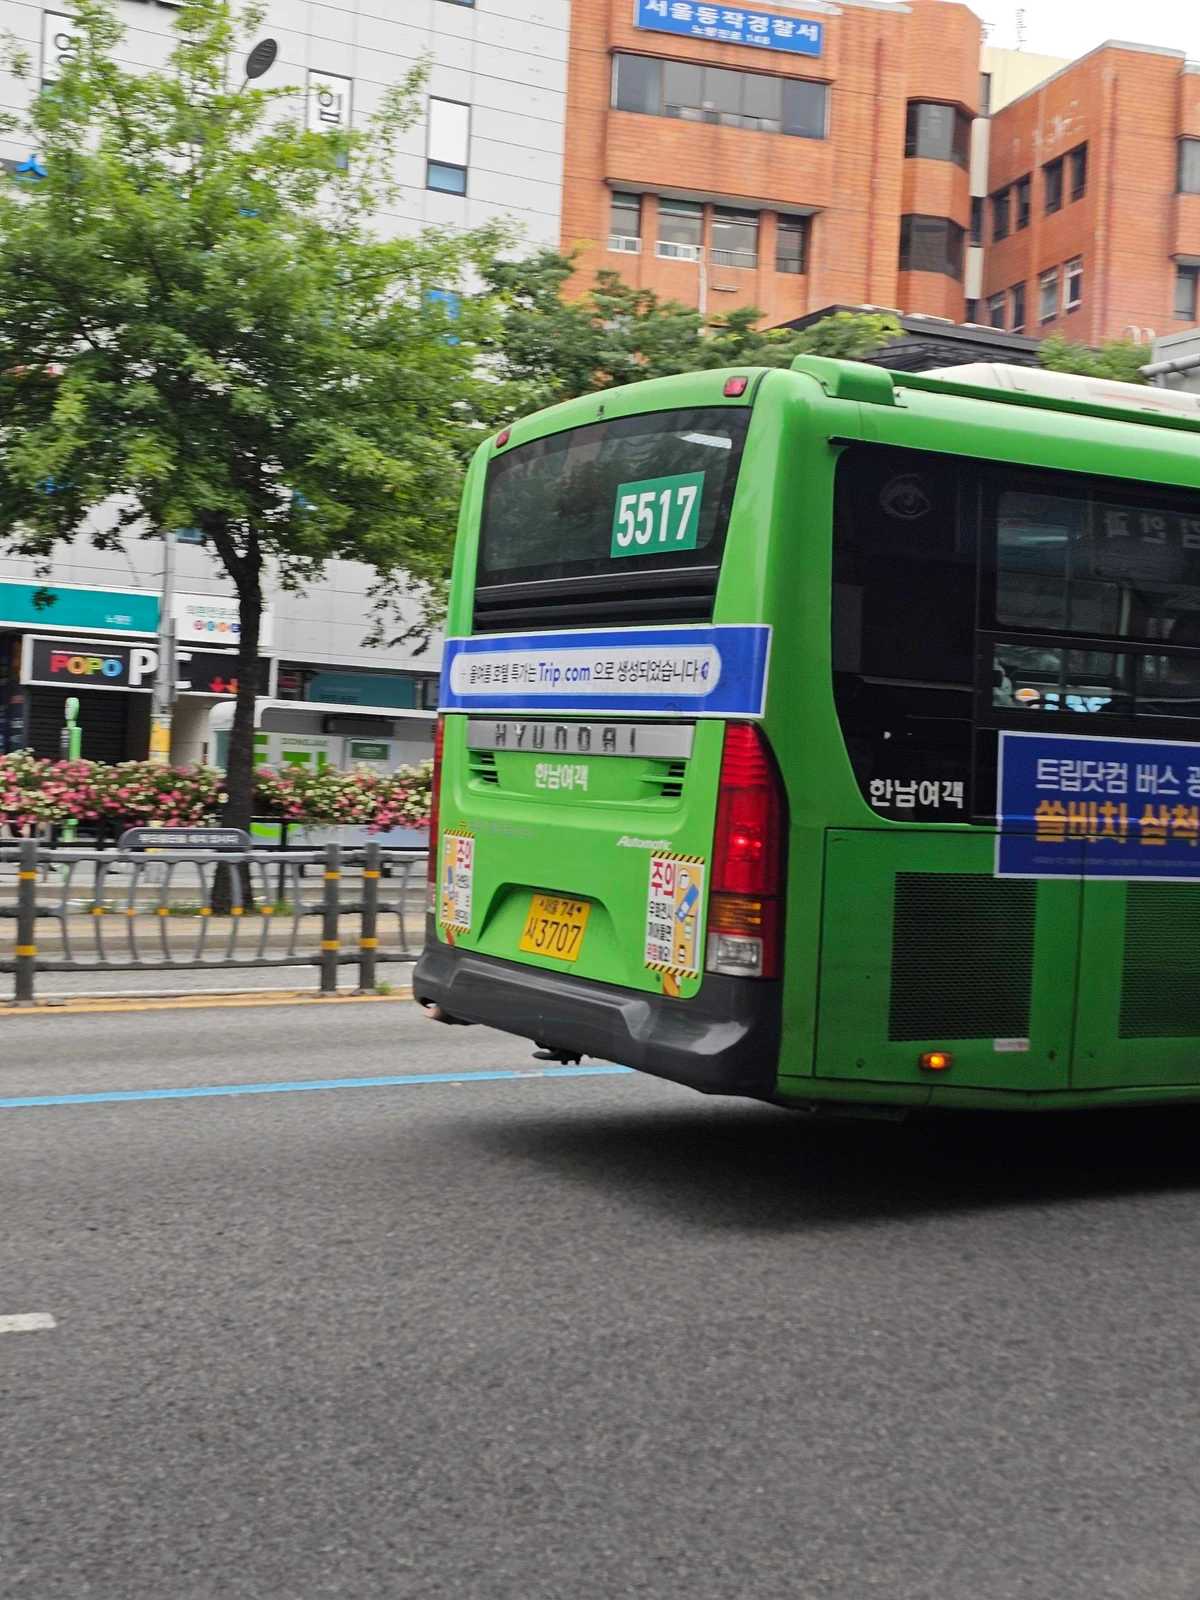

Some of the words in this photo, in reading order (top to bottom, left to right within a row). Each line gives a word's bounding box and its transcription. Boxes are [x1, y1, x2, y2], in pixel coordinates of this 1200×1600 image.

[644, 0, 819, 42] 서울동작경찰서
[616, 485, 698, 547] 5517
[50, 655, 123, 677] POPO
[470, 664, 492, 684] 올여름
[493, 663, 509, 683] 호텔
[511, 663, 537, 683] 특가는
[539, 662, 591, 687] Trip.com
[617, 659, 699, 683] 생성되었습니다
[495, 723, 636, 753] HYUNDAI
[535, 762, 589, 791] 한남여객
[1035, 758, 1129, 794] 트립닷컴
[1135, 763, 1181, 795] 버스
[869, 778, 964, 809] 한남여객
[1034, 799, 1129, 844] 쏠비치
[1139, 803, 1199, 847] 삼척
[456, 840, 472, 870] 주의
[615, 836, 673, 851] Automatic
[651, 861, 677, 898] 주의
[560, 901, 576, 918] 74
